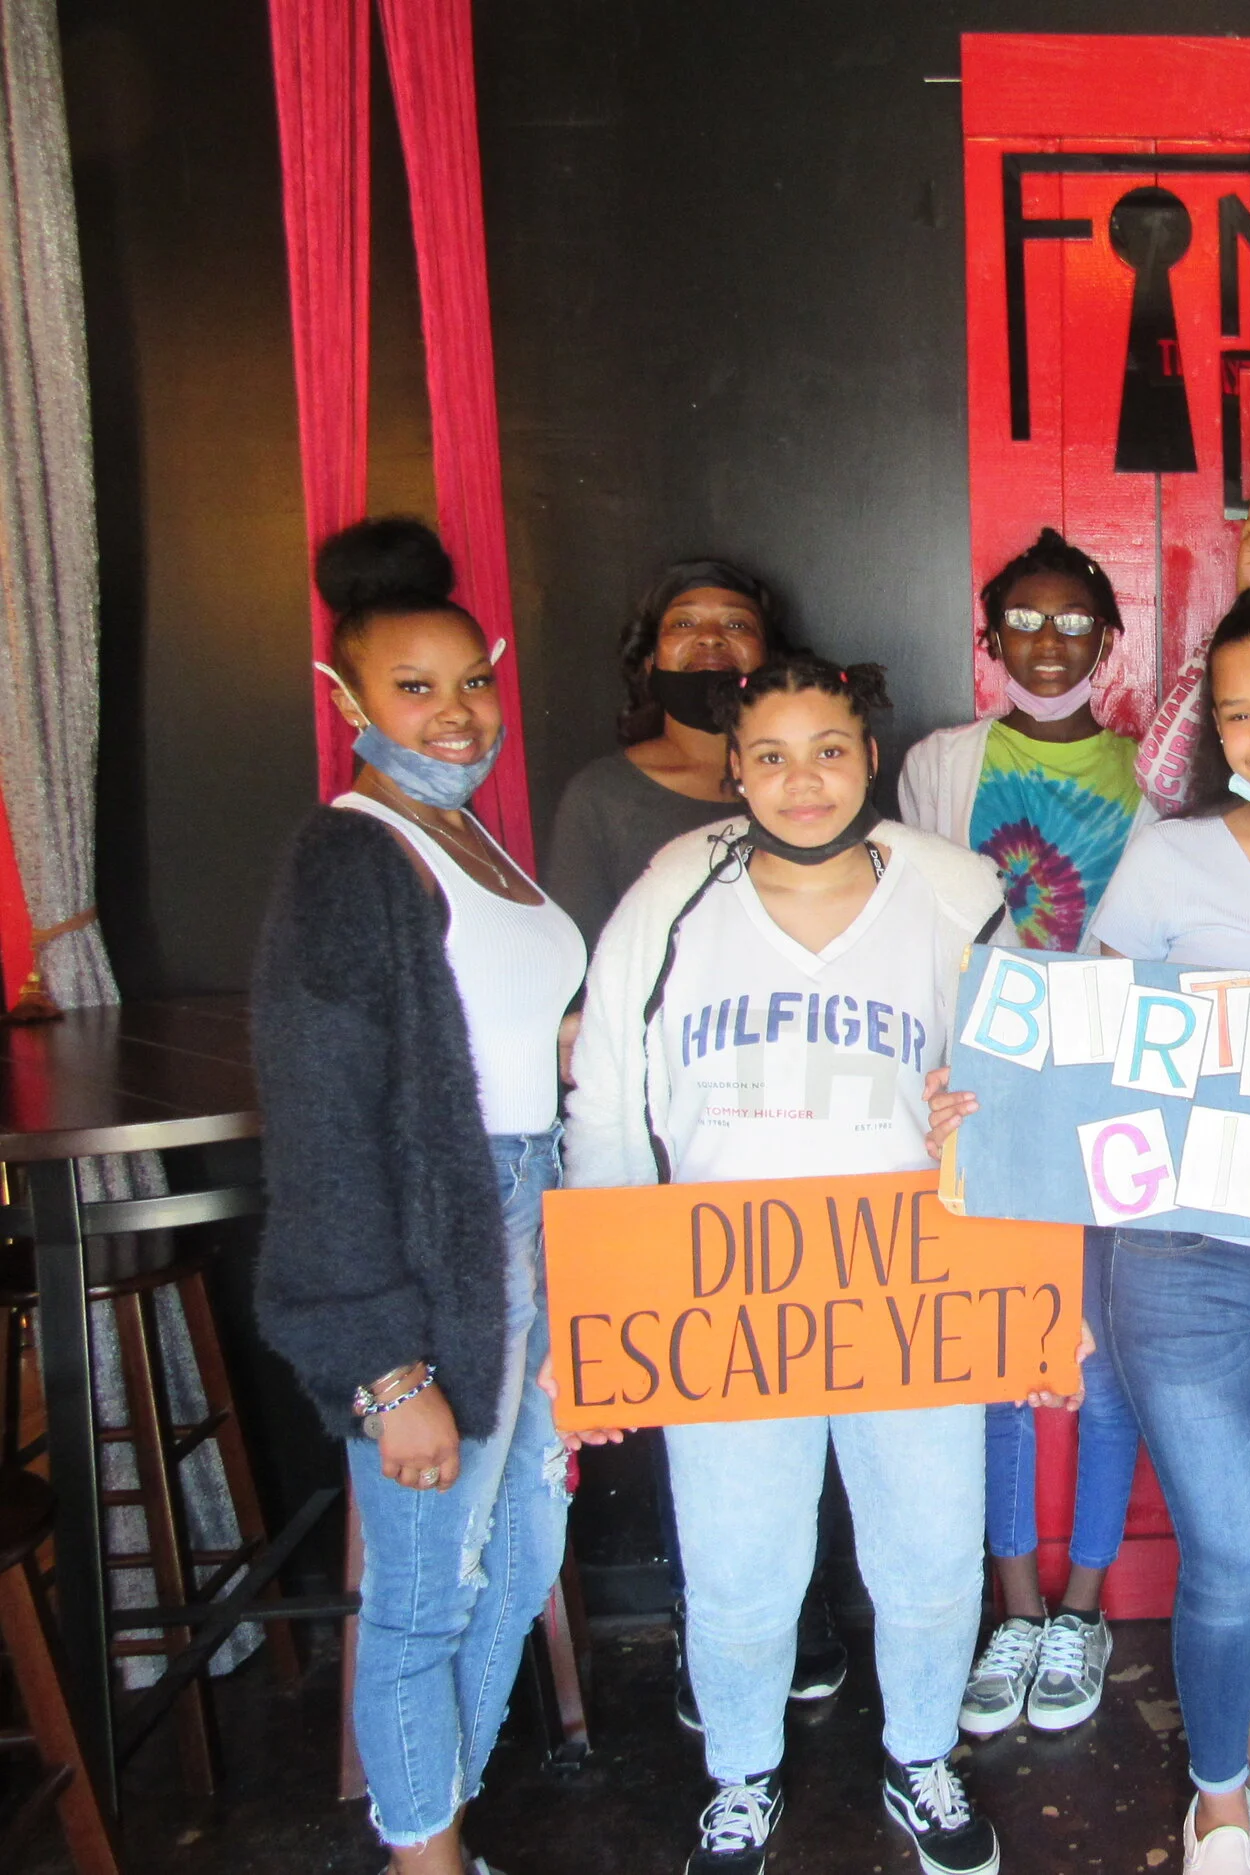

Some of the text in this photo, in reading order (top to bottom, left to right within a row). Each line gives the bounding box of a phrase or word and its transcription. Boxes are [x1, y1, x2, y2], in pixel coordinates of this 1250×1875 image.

[682, 992, 926, 1073] HILFIGER
[706, 1107, 814, 1119] TOMMY HILFIGER
[691, 1190, 950, 1299] DID WE
[570, 1283, 1062, 1407] ESCAPE YET?
